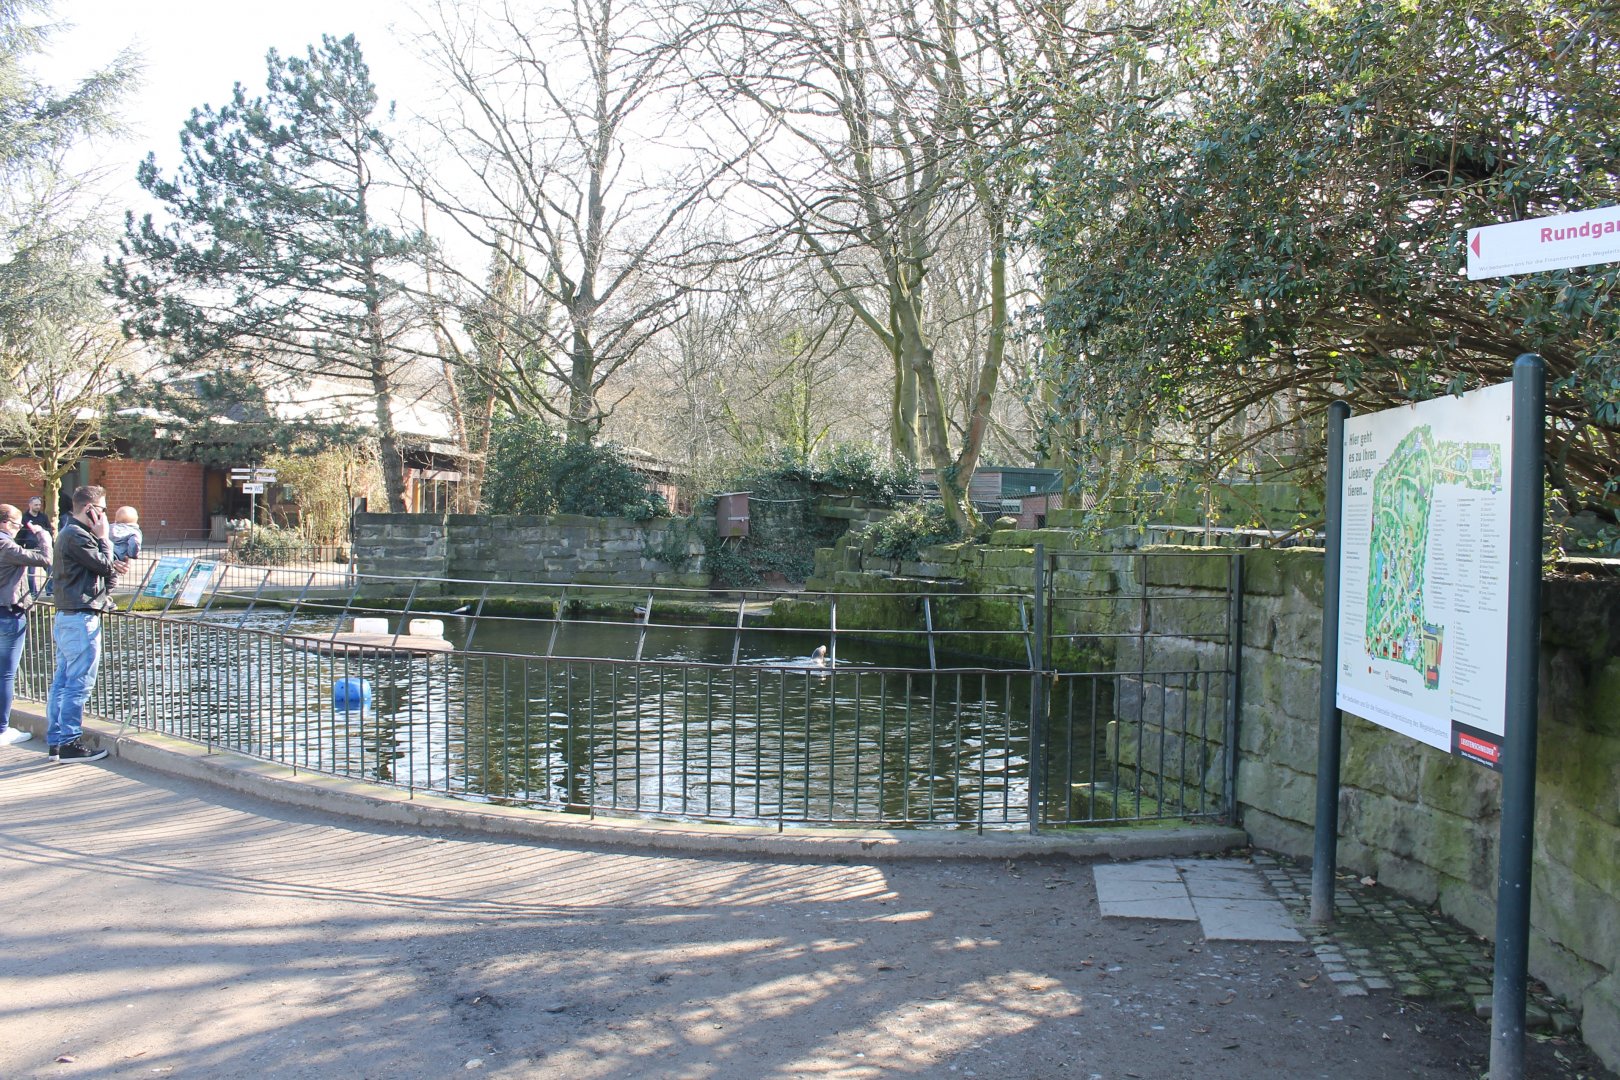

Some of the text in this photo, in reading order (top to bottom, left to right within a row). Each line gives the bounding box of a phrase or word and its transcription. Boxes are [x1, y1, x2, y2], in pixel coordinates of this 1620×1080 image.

[1541, 221, 1620, 243] Rundga
[1349, 430, 1373, 447] Hier geht
[1348, 449, 1377, 463] es zu Ihren
[1348, 466, 1374, 481] Lieblings-
